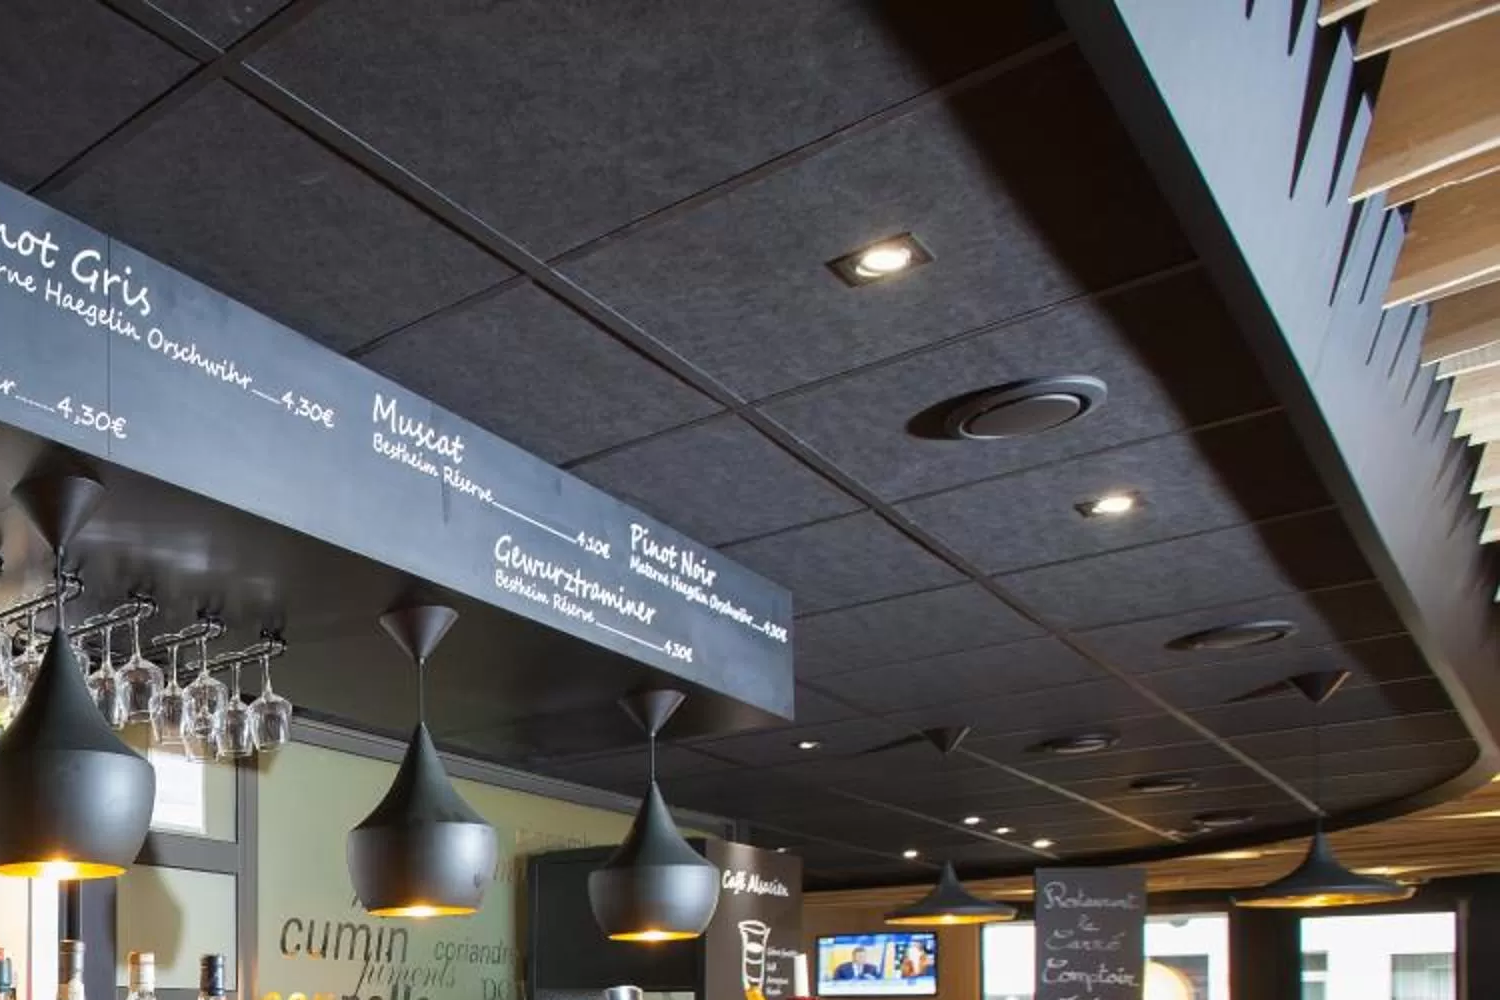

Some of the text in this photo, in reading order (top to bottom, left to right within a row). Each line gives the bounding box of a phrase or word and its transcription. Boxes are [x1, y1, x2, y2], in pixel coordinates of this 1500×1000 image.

[70, 248, 151, 316] Gris
[44, 278, 141, 341] Haegelin
[147, 327, 254, 391] Orschwihr
[280, 390, 336, 429] 4,30€
[56, 395, 128, 440] 4,30€
[372, 393, 465, 464] Muscat
[372, 432, 440, 477] Bestheim
[442, 465, 494, 503] Réserve
[494, 534, 657, 625] Gewurztraminer
[629, 523, 718, 588] Pinot Noir
[494, 568, 550, 606] Bestheim
[552, 593, 596, 624] Réserve
[280, 916, 410, 964] cumin
[1042, 956, 1141, 993] Comptoir
